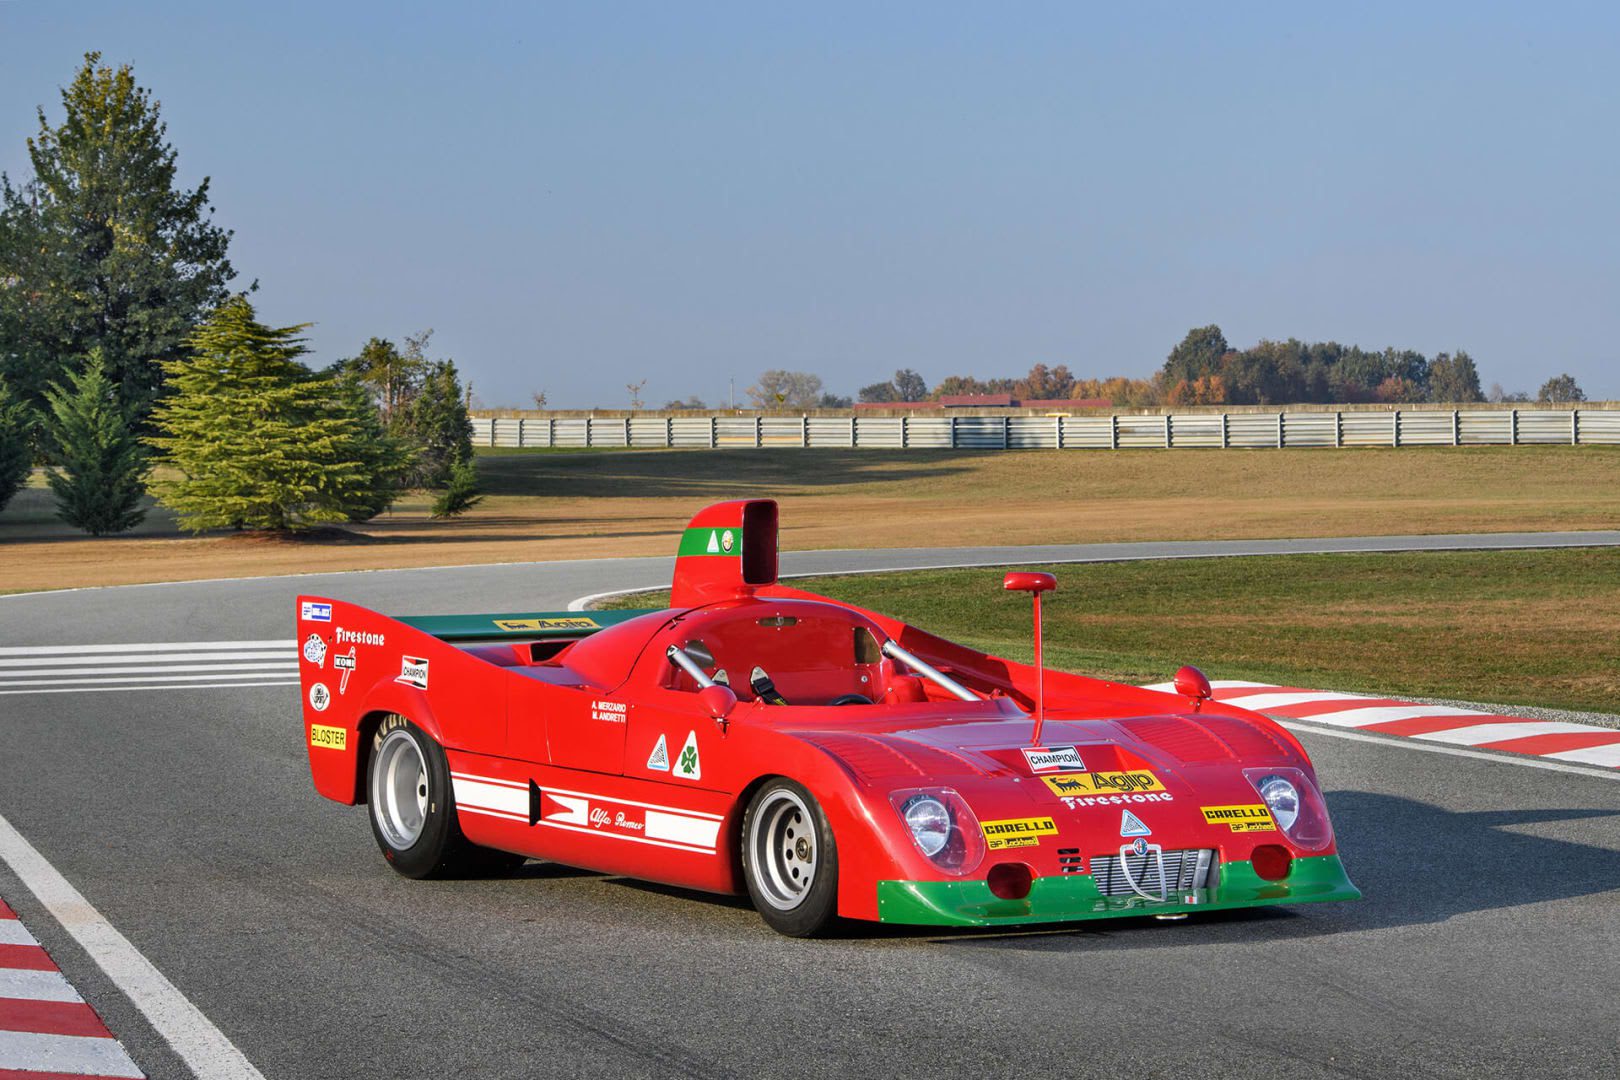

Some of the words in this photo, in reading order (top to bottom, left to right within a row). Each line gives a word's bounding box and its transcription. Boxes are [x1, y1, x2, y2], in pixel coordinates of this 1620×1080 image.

[336, 627, 385, 646] Firestone
[403, 666, 426, 679] CHAMPION
[598, 701, 626, 713] MERZARIO
[598, 712, 626, 723] ANDRETTI
[312, 728, 345, 745] BLOSTER
[1030, 753, 1079, 765] CHAMPION
[1090, 772, 1155, 792] Agip
[1060, 792, 1174, 810] Firestone
[590, 807, 611, 828] Alfa
[615, 811, 645, 830] Romeo
[1204, 808, 1269, 819] CARELLO
[984, 821, 1055, 835] CARELLO
